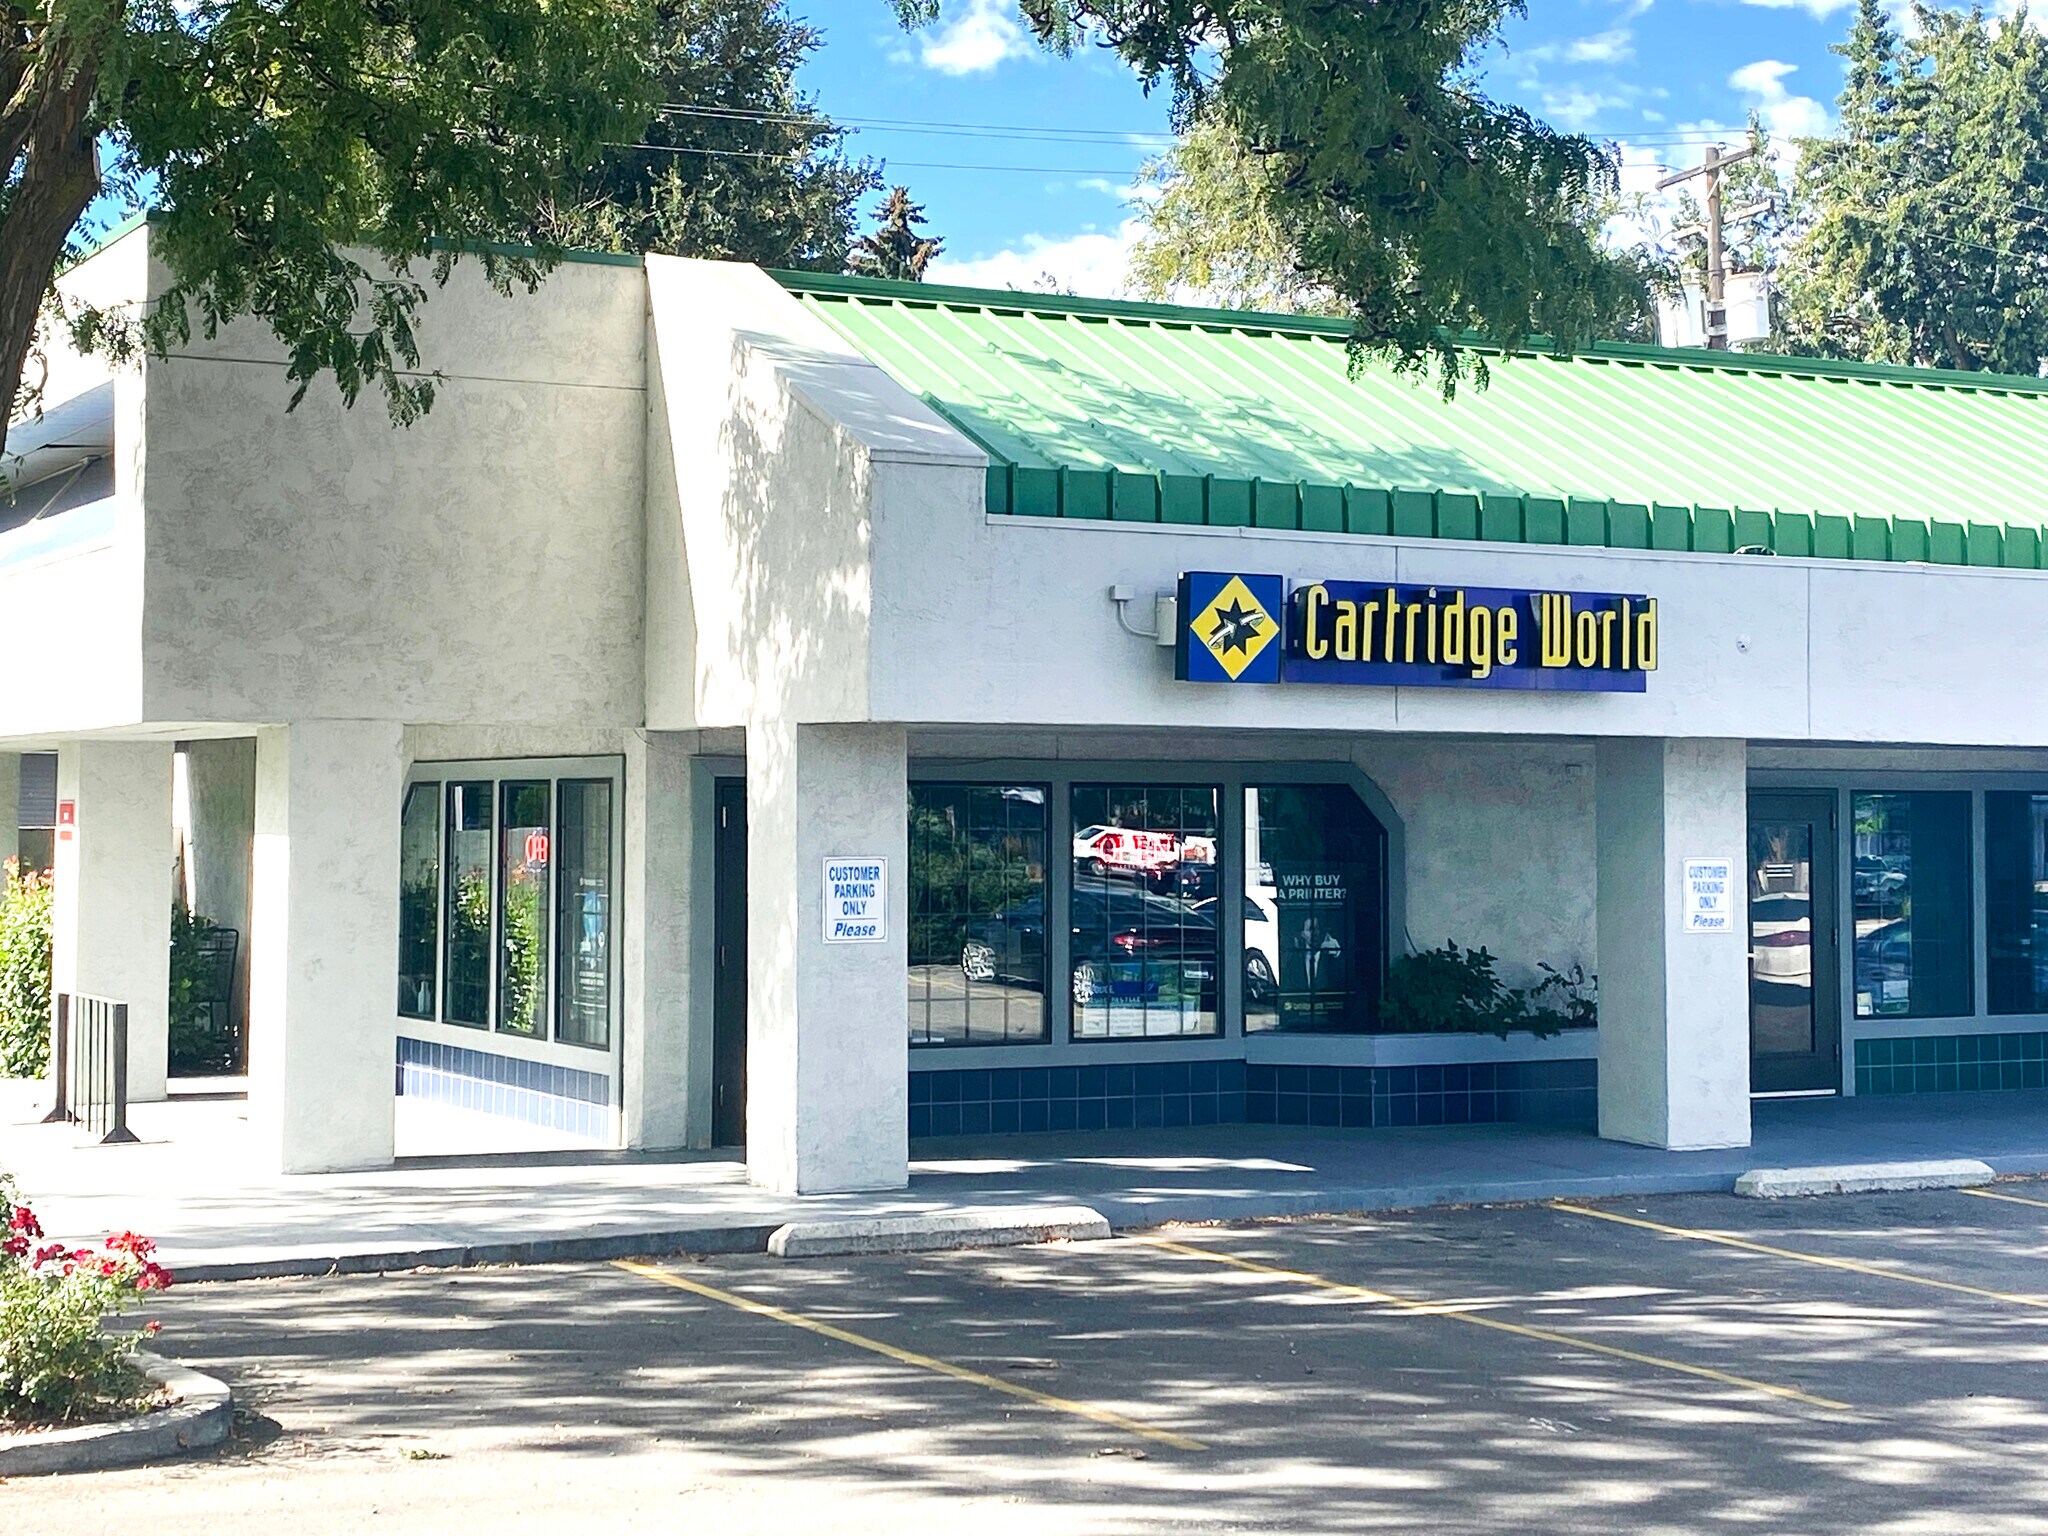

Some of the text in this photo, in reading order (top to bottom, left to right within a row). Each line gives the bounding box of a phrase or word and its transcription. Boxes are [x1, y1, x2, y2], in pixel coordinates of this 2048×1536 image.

[1306, 584, 1657, 679] Cartridge World
[829, 866, 880, 881] CUSTOMER
[1688, 866, 1728, 878] CUSTOMER
[1282, 874, 1340, 886] WHY BUY
[834, 883, 875, 898] PARKING
[1278, 888, 1286, 899] A
[1692, 881, 1725, 894] PARKING
[842, 901, 867, 916] ONLY
[1699, 896, 1717, 908] ONLY
[1693, 914, 1725, 927] Please
[834, 922, 876, 937] Please
